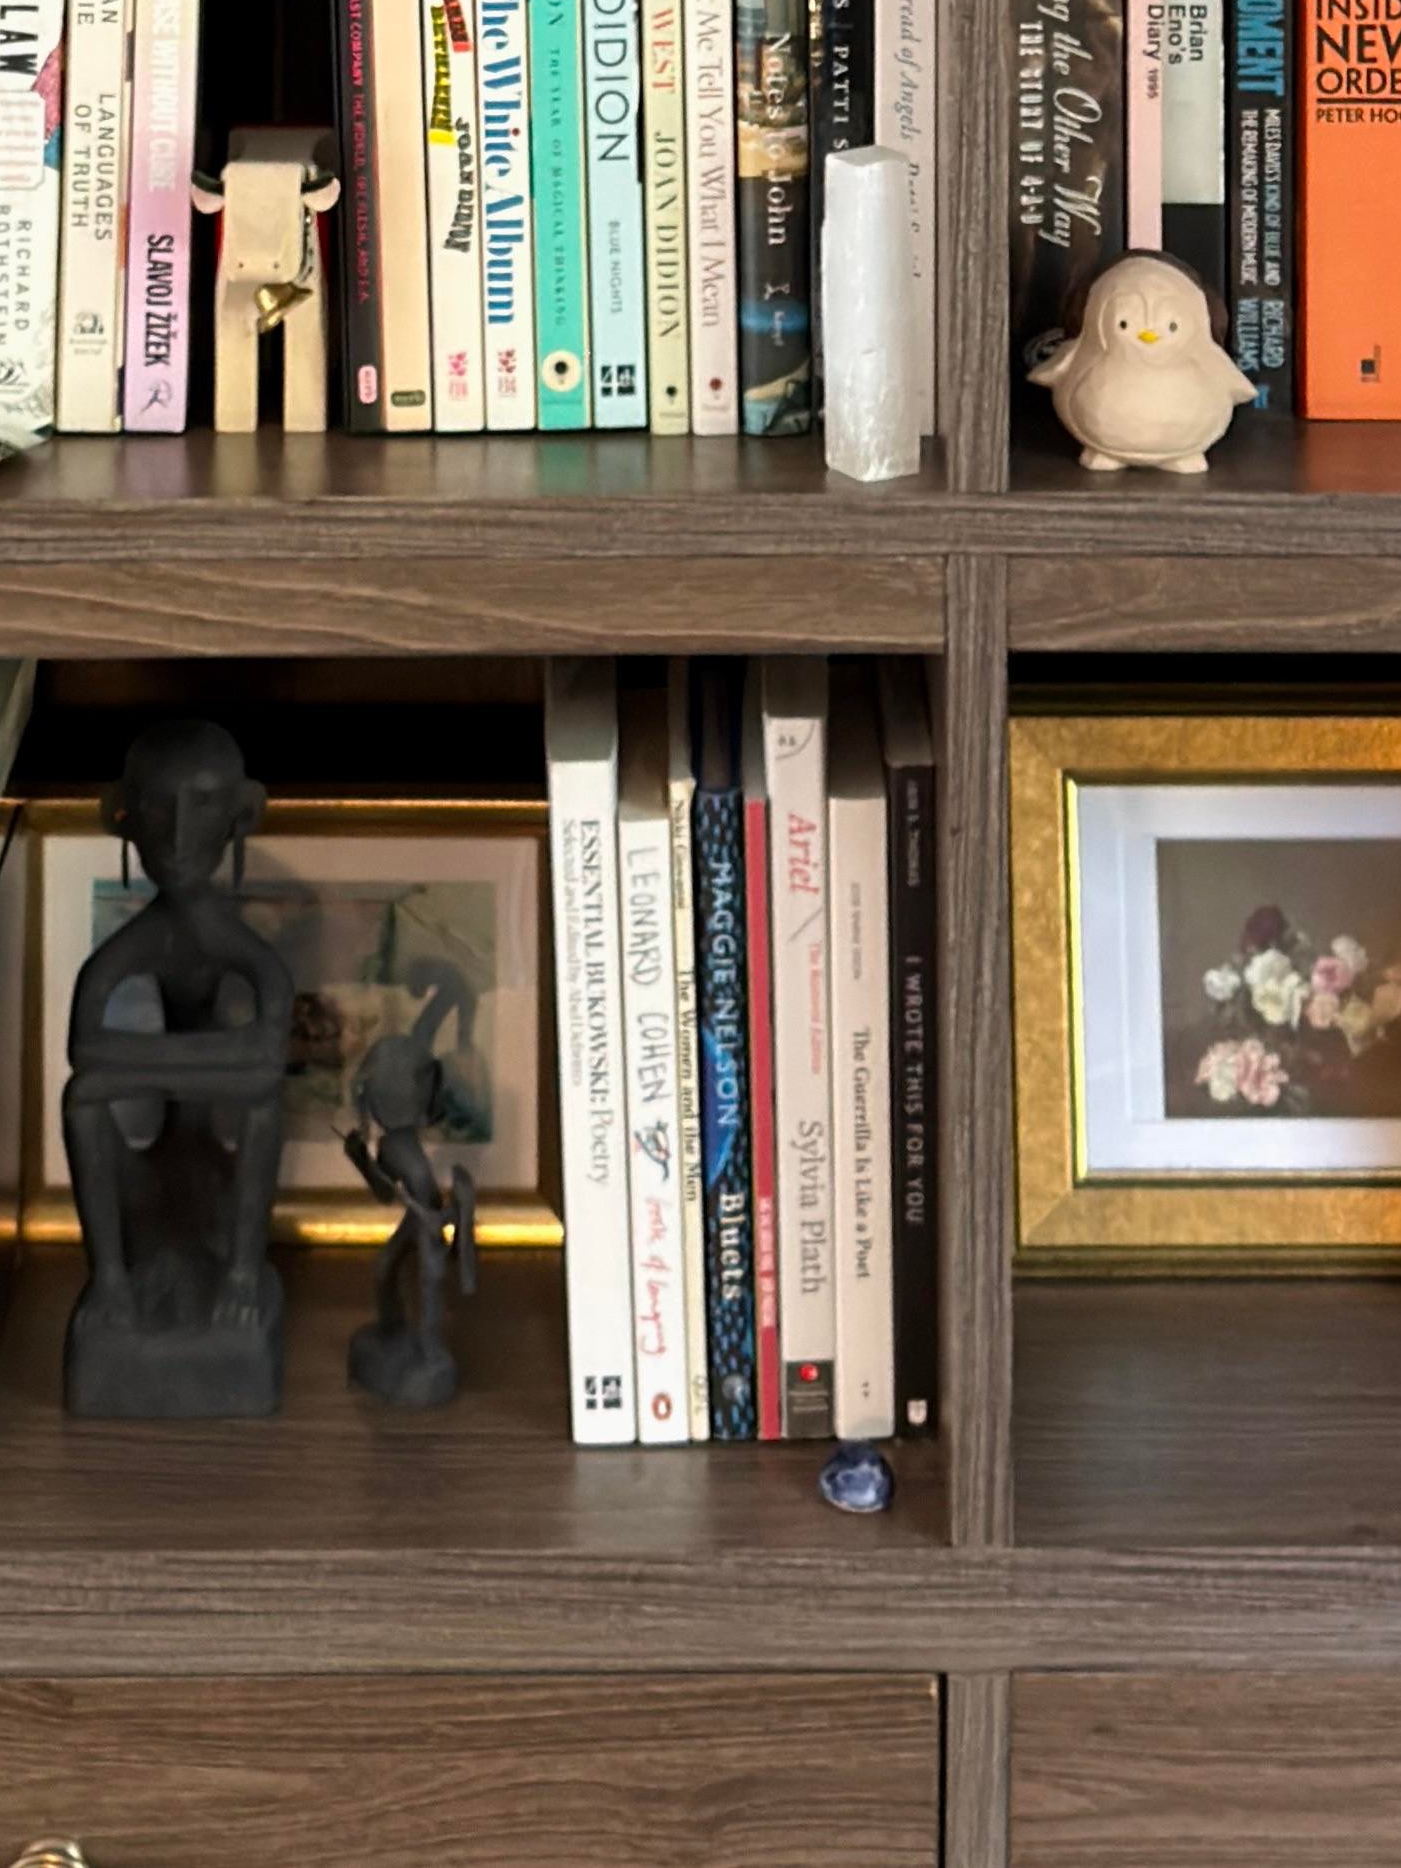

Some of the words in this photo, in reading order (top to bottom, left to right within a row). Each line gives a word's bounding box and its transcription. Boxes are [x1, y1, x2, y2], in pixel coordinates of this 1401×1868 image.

[481, 53, 522, 177] White
[1316, 107, 1366, 124] PETER
[484, 183, 525, 326] Album
[708, 860, 738, 986] MAGGIE
[716, 1000, 739, 1130] NELSON
[718, 1193, 744, 1302] Bluets
